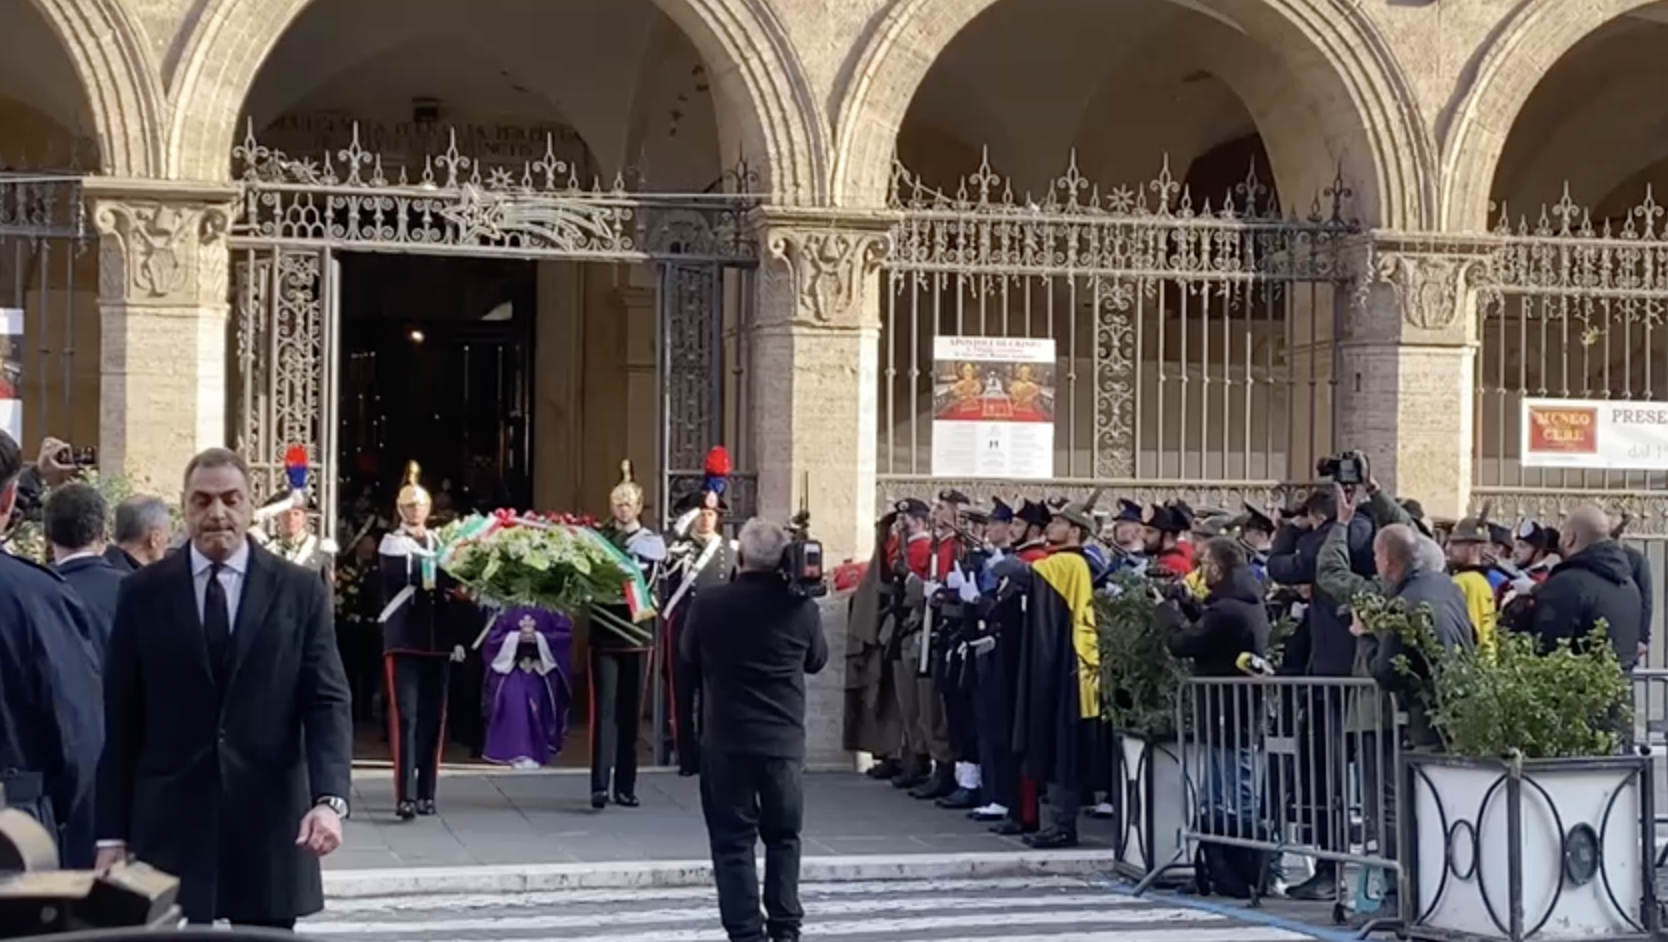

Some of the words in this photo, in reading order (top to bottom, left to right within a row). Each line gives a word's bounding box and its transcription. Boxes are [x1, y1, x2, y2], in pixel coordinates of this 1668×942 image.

[1536, 411, 1591, 425] MUSEO
[1611, 408, 1668, 425] PRESE
[1627, 444, 1650, 459] dal
